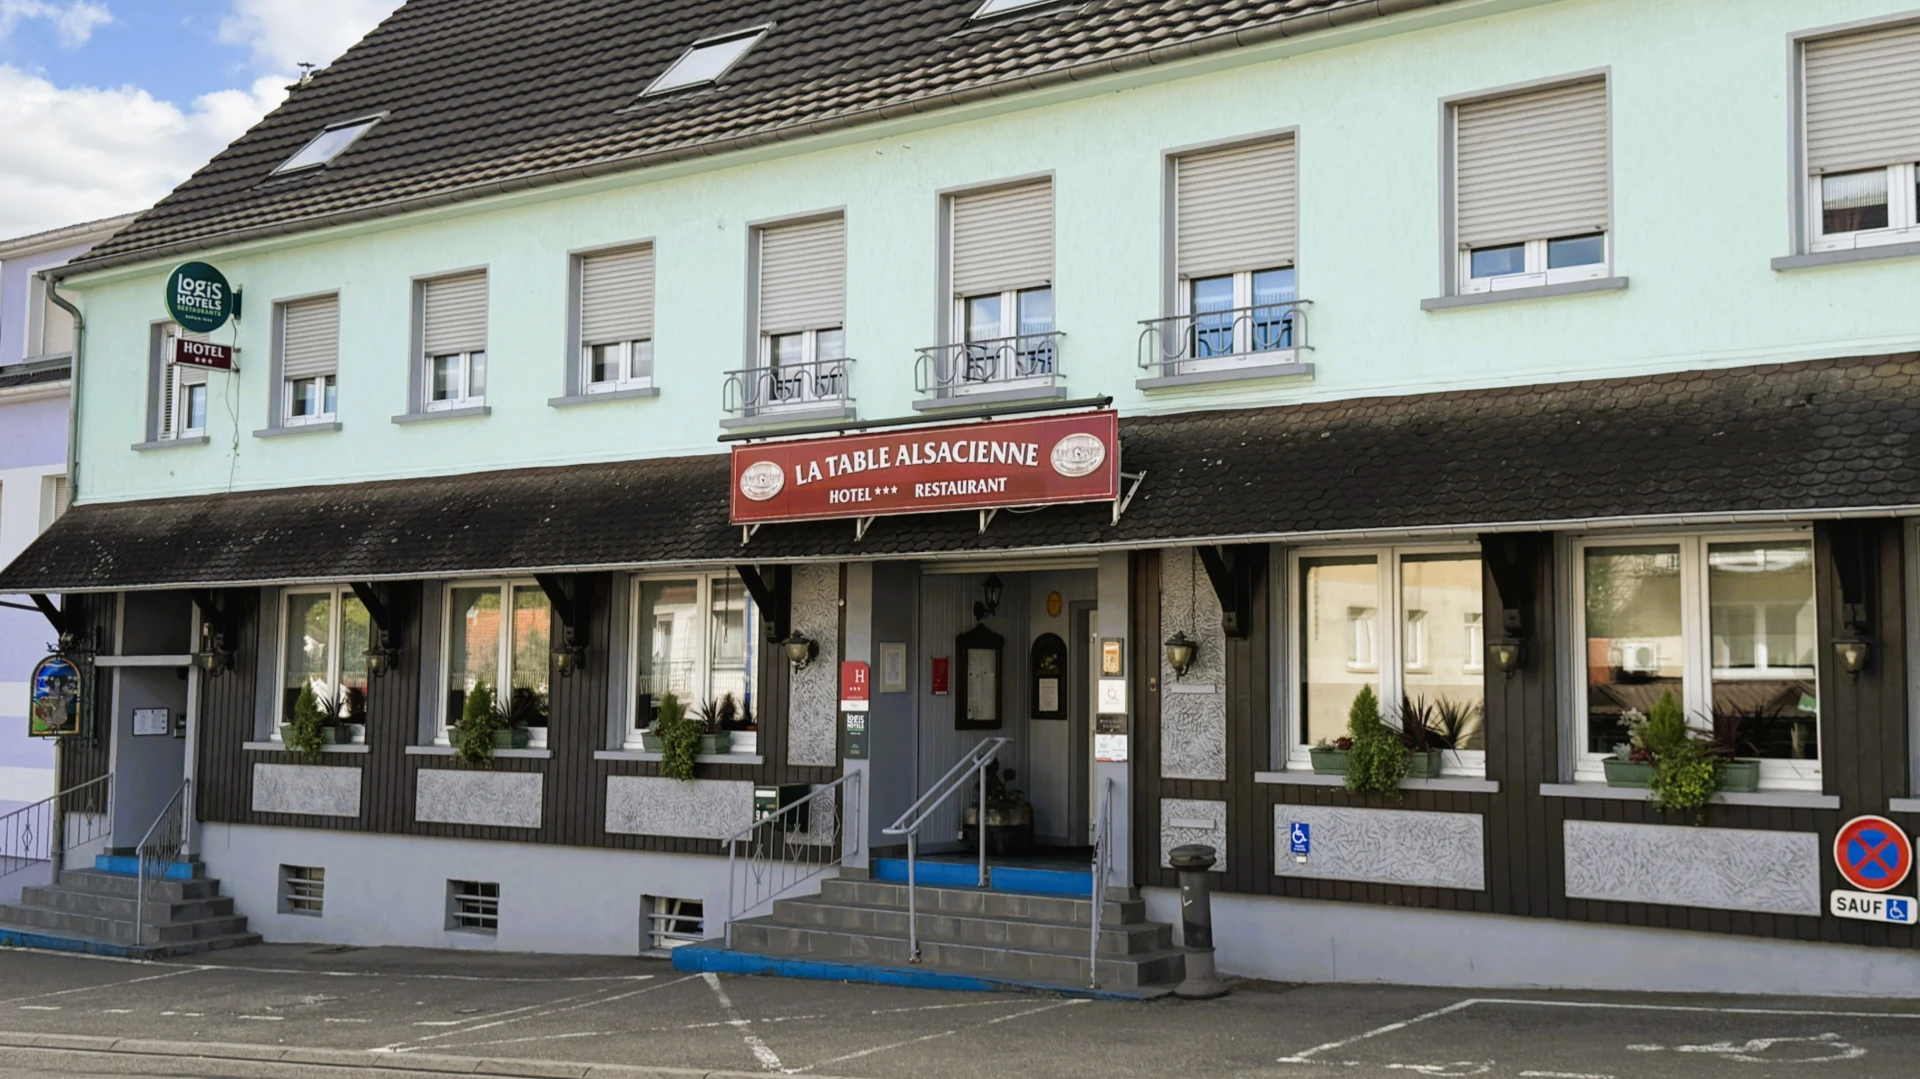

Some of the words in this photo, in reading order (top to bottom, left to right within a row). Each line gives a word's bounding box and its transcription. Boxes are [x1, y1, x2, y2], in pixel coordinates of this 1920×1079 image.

[177, 294, 221, 311] HOTELS
[177, 305, 221, 317] RESTAURANTS
[183, 341, 224, 358] HOTEL
[795, 460, 823, 486] LA
[825, 446, 891, 478] TABLE
[895, 440, 1039, 467] ALSACIENNE
[829, 487, 872, 504] HOTEL
[914, 477, 1007, 498] RESTAURANT
[855, 669, 865, 683] H
[1836, 896, 1882, 914] SAUF
